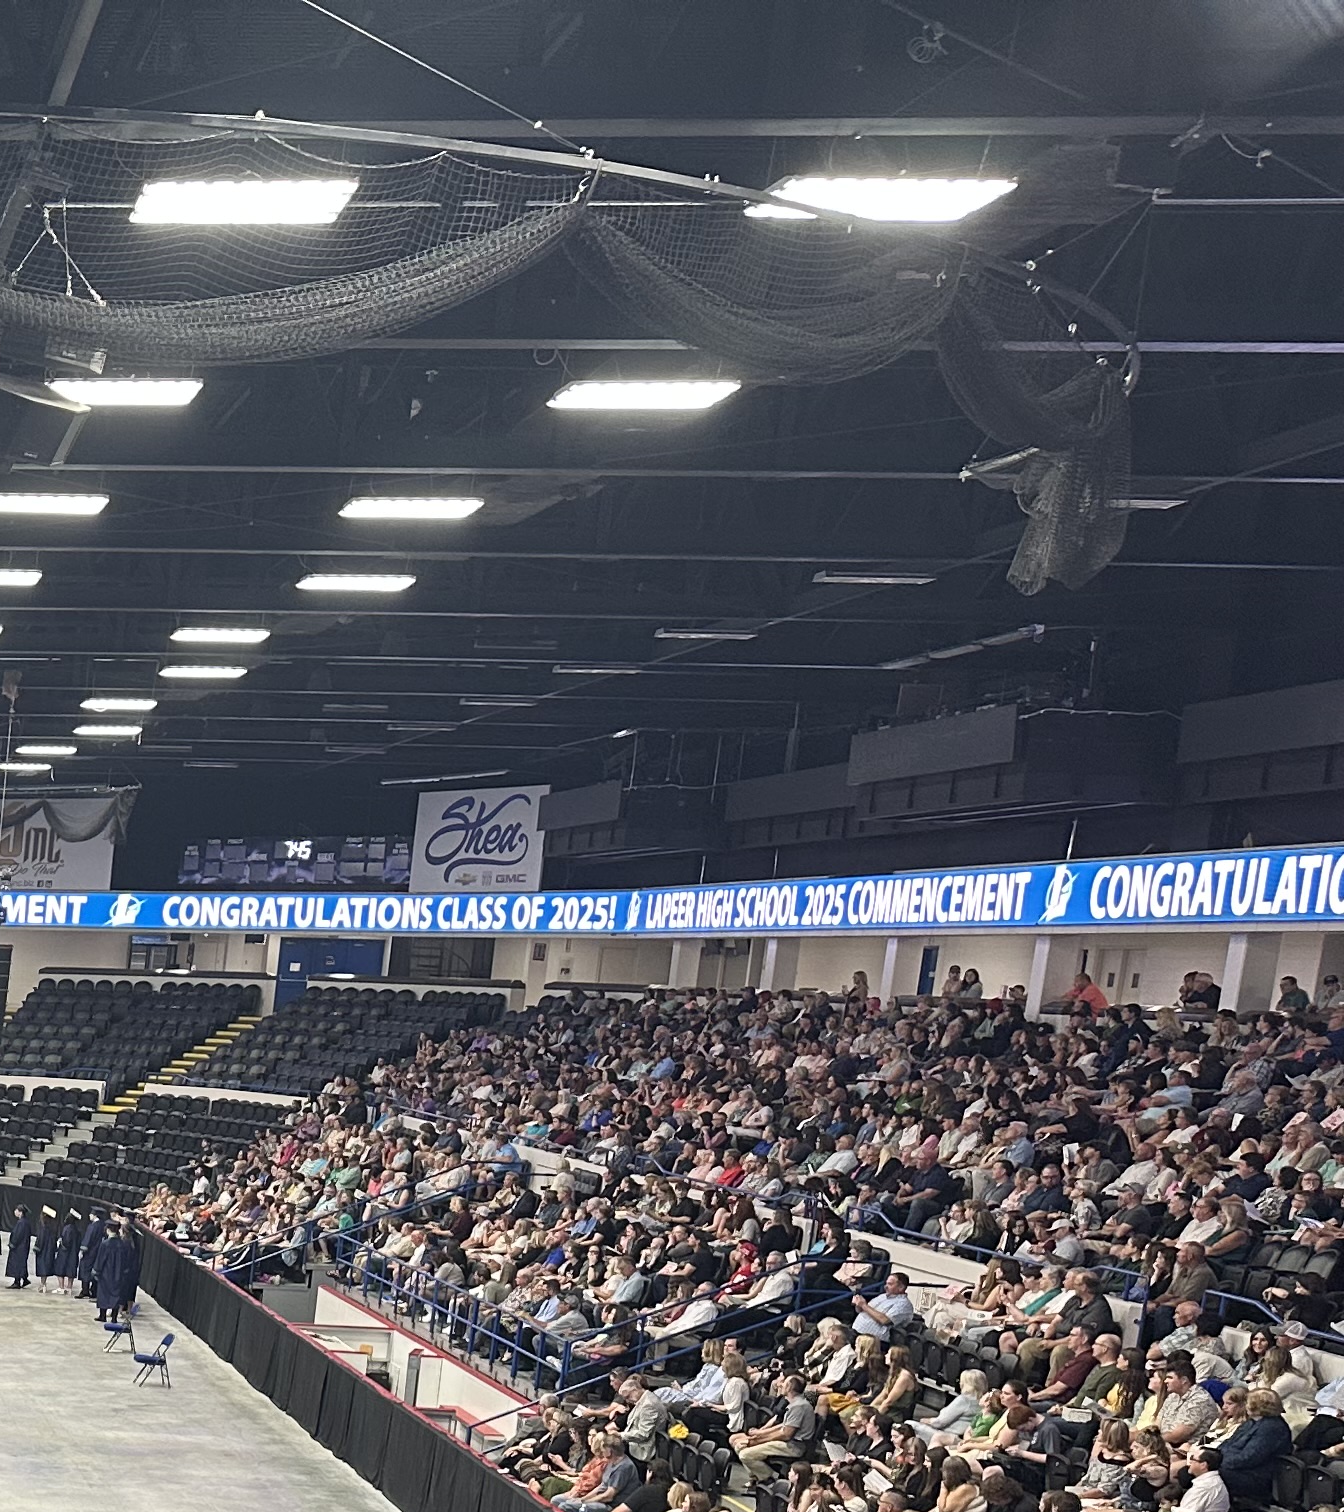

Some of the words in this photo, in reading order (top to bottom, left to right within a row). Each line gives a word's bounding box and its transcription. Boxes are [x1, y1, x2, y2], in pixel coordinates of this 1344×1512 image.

[425, 793, 532, 873] Shea
[495, 873, 528, 884] GMC
[645, 892, 696, 929] LAPEER
[696, 889, 735, 929] HIGH
[734, 885, 799, 928] SCHOOL
[800, 884, 847, 926] 2025
[848, 871, 1032, 925] COMMENCEMENT
[162, 896, 433, 930] CONGRATULATIONS
[436, 897, 508, 931] CLASS
[511, 896, 546, 930] OF
[548, 894, 618, 931] 2025!
